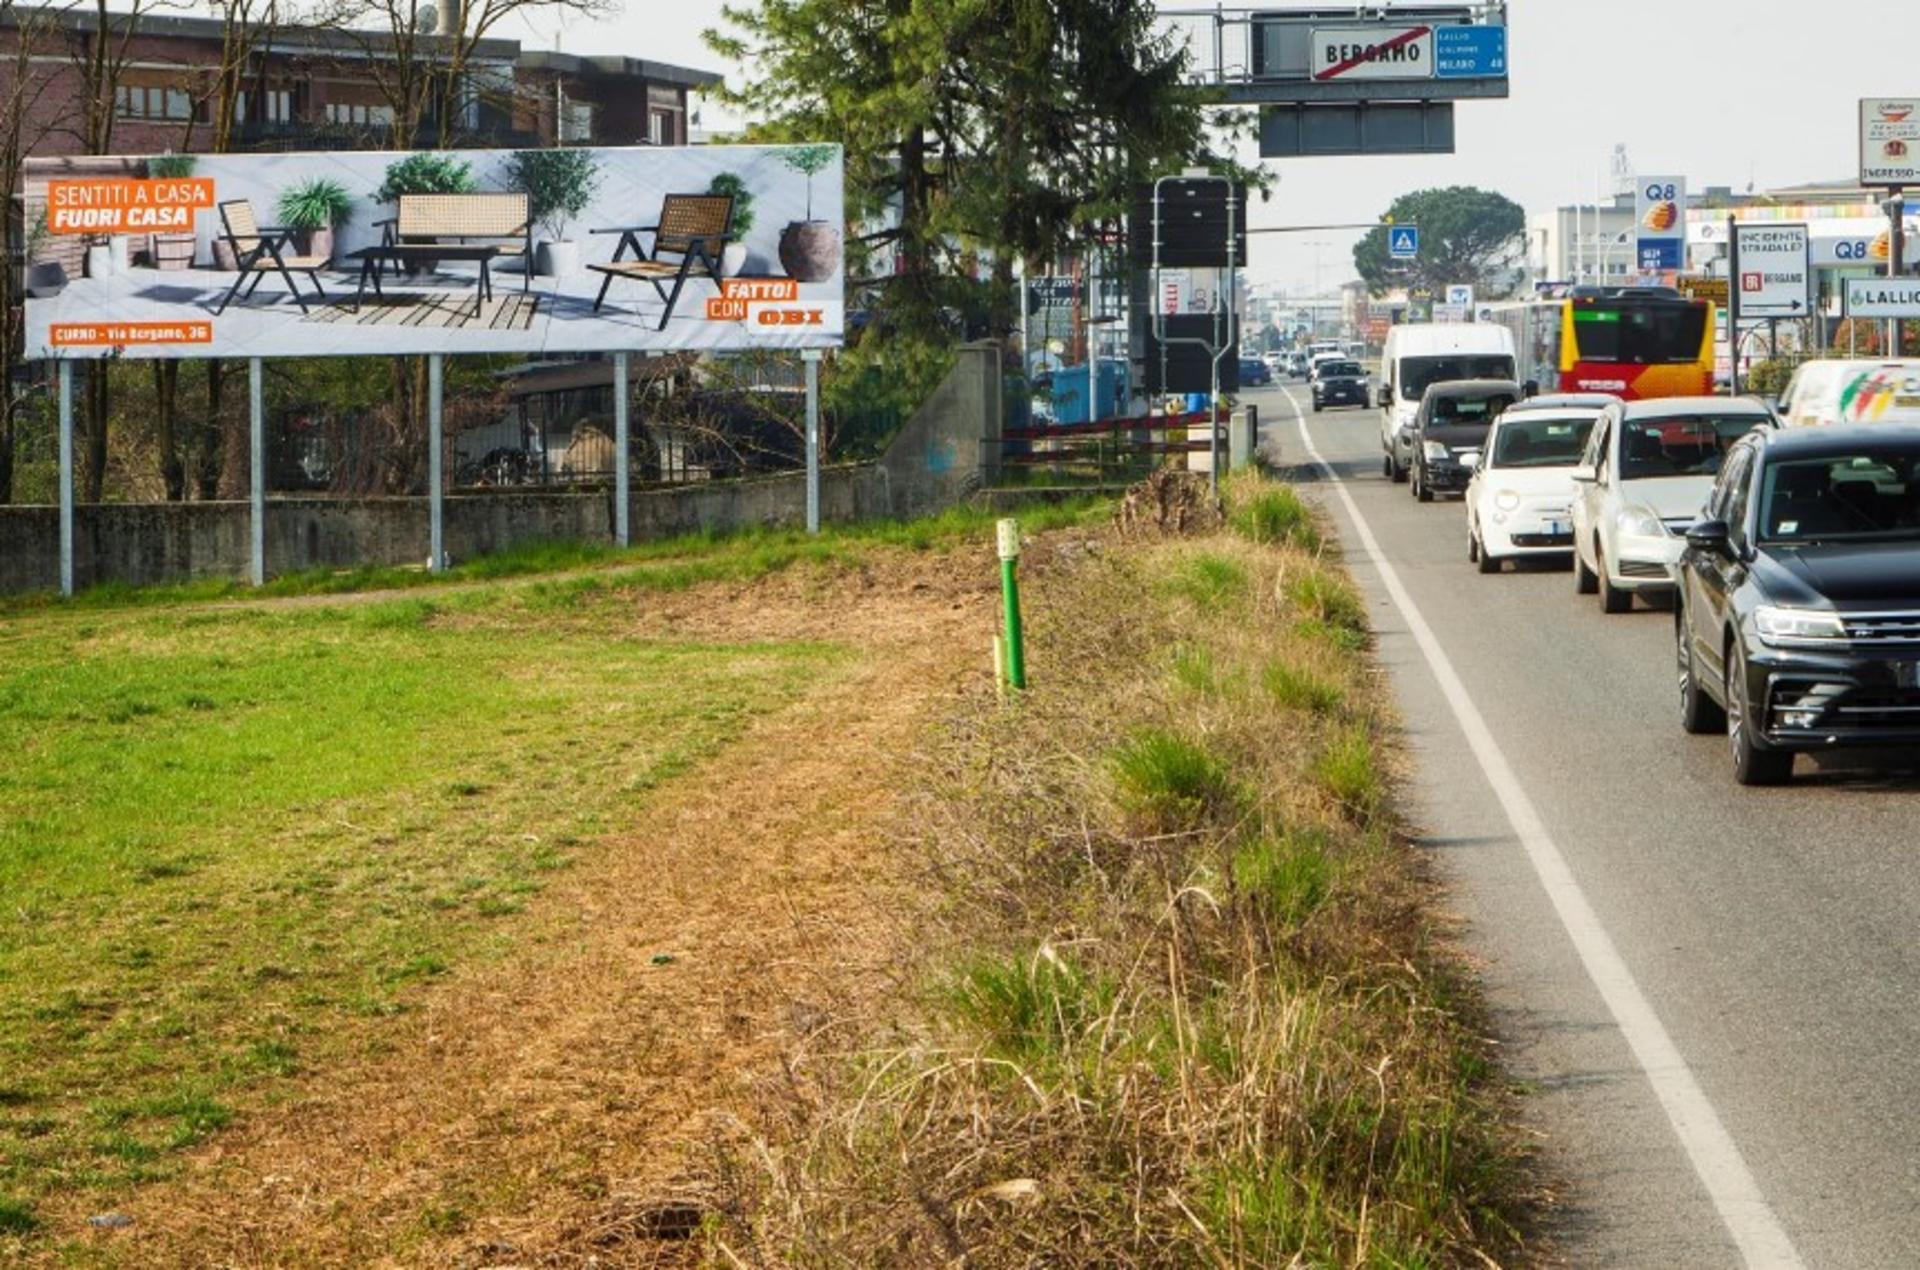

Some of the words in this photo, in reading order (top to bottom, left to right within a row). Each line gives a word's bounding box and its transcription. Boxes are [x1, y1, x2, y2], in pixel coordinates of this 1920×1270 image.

[1326, 43, 1420, 62] BERGAMO
[1863, 168, 1915, 179] INGRESSO
[55, 185, 128, 206] SENTITI
[135, 185, 148, 204] A
[155, 183, 207, 203] CASA
[1646, 184, 1675, 201] Q8
[55, 208, 122, 228] FUORI
[127, 206, 188, 226] CASA
[1741, 231, 1803, 242] INCIDENTE
[1741, 242, 1803, 253] STRADALE?
[1835, 241, 1866, 259] Q8
[726, 282, 793, 299] FATTO!
[711, 300, 744, 318] CON
[758, 309, 824, 326] OBI
[55, 328, 97, 341] CURNO
[107, 328, 126, 340] Via
[129, 327, 186, 341] Bergamo,
[188, 326, 208, 339] 36
